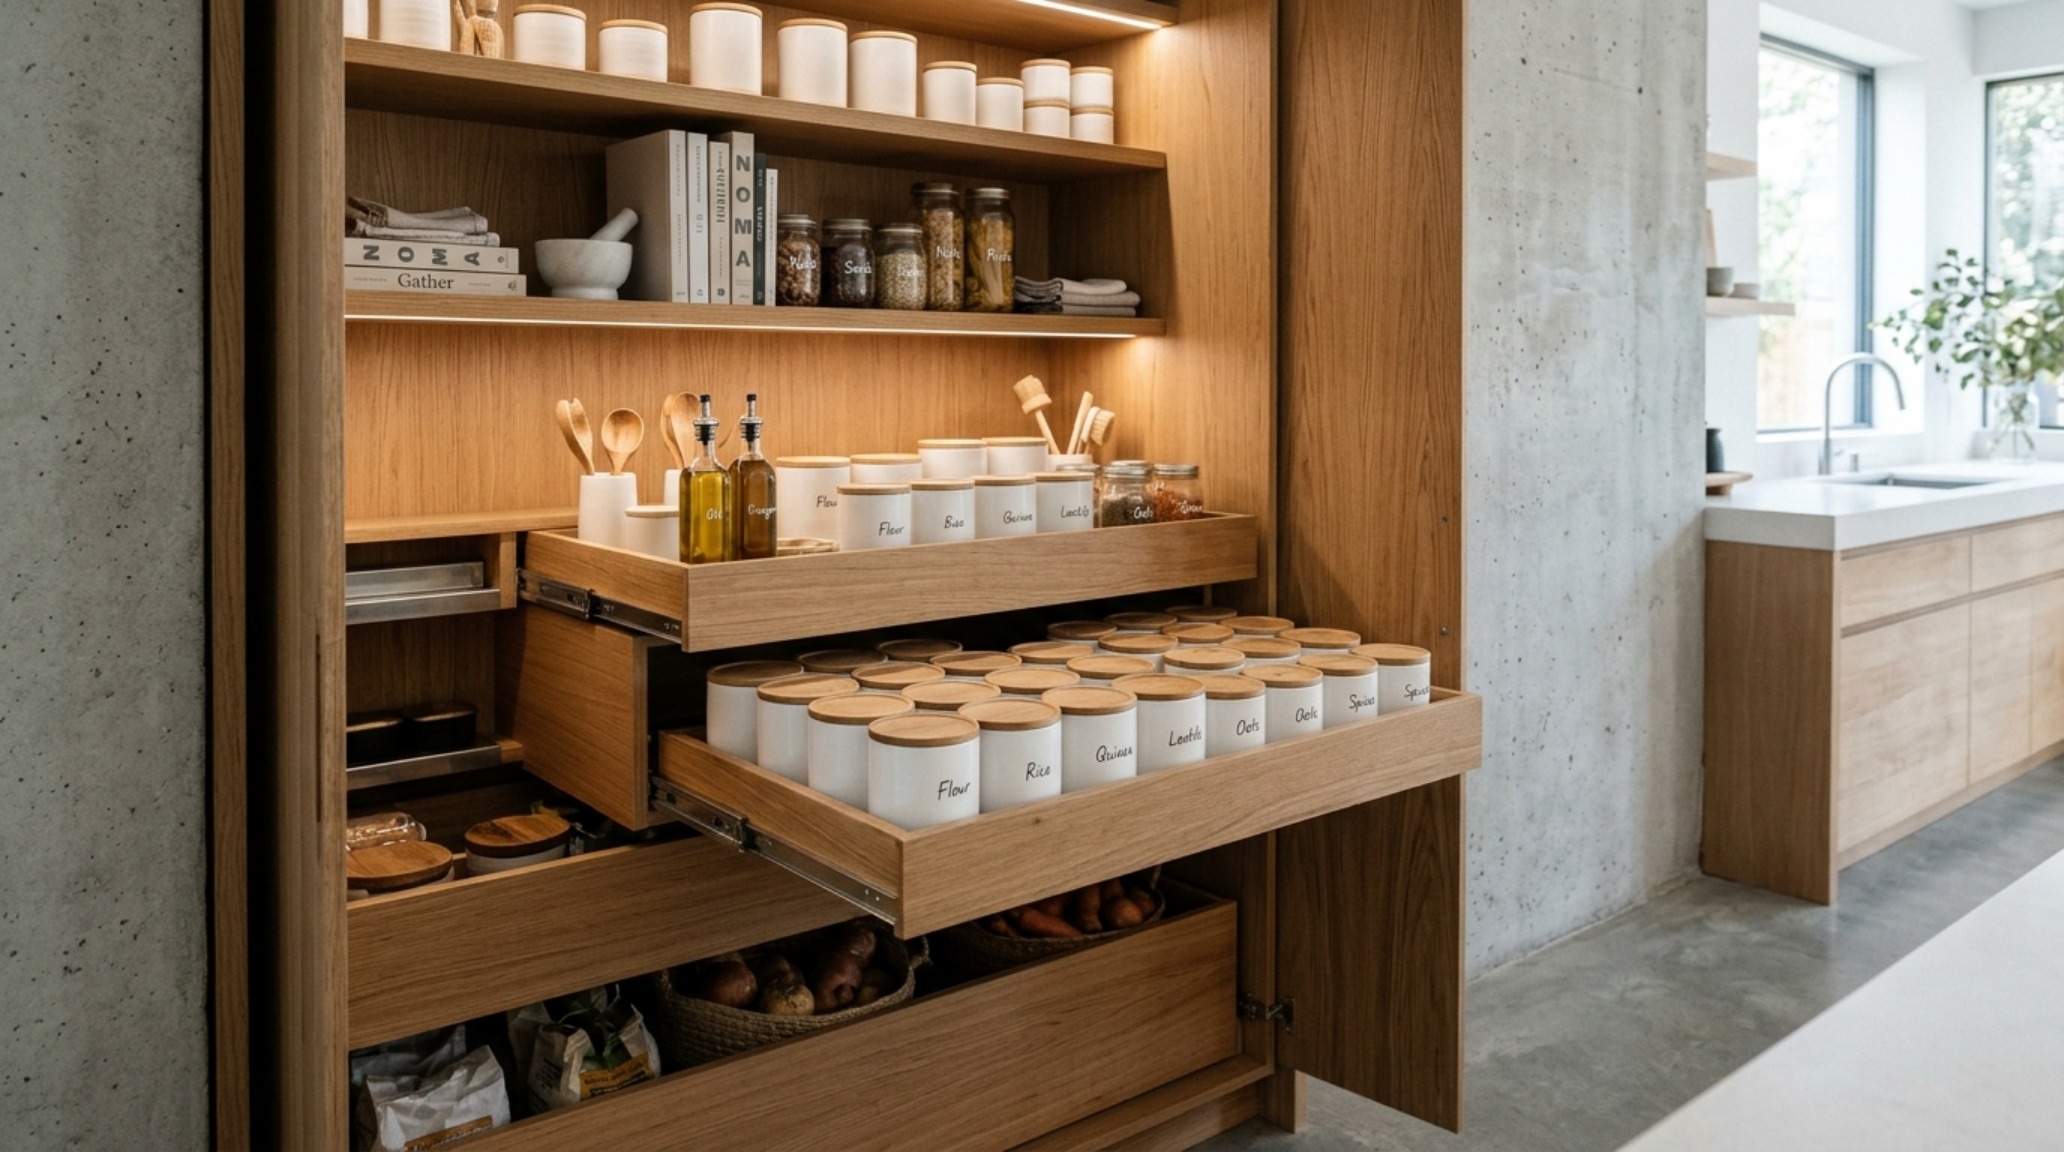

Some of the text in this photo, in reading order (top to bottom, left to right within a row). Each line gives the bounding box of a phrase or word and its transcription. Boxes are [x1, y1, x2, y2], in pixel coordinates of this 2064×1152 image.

[735, 154, 752, 268] NOMA
[363, 244, 480, 267] NOMA
[397, 272, 455, 290] Gather
[937, 779, 971, 800] Flour
